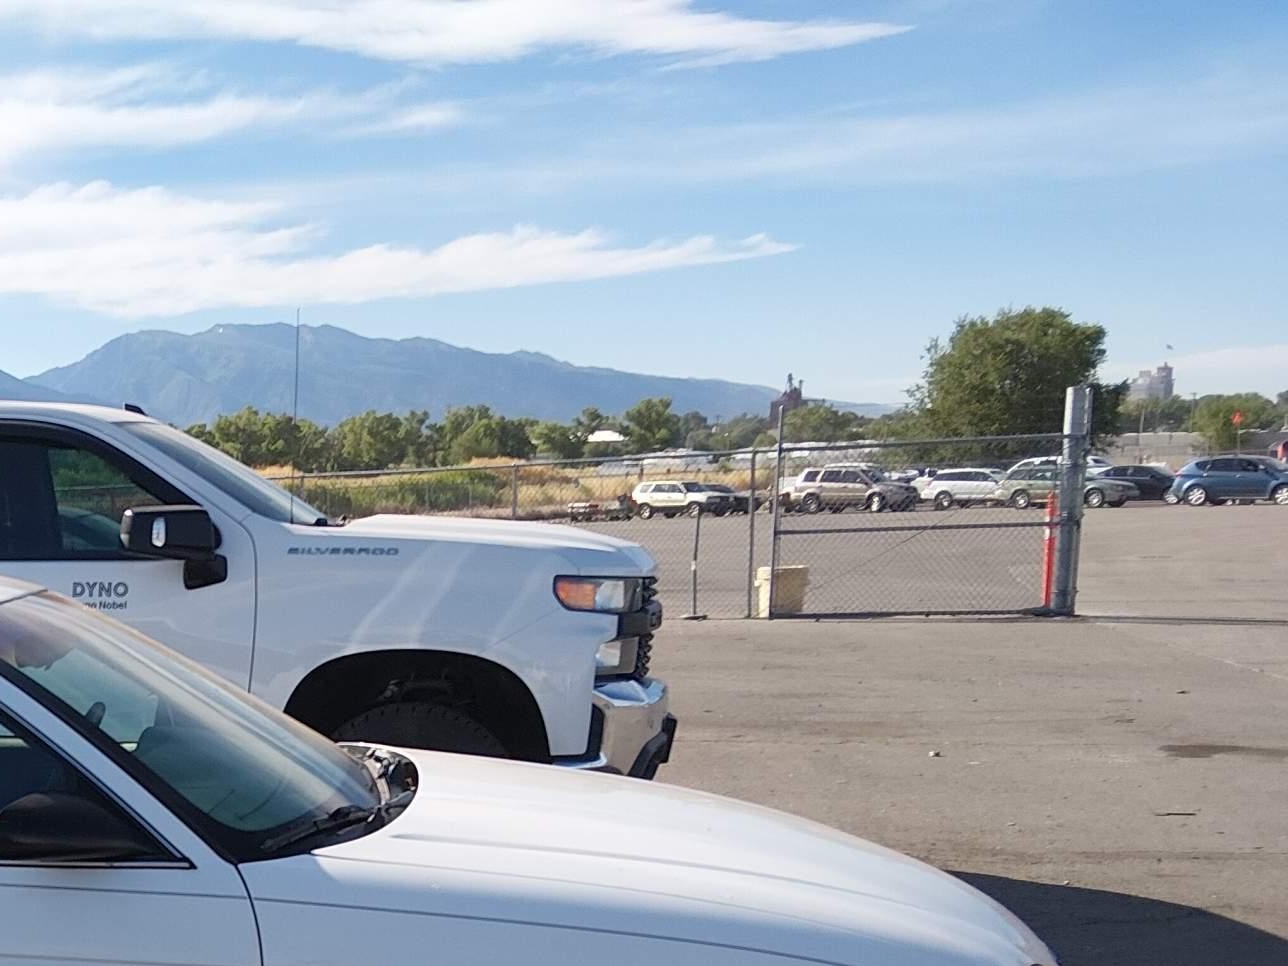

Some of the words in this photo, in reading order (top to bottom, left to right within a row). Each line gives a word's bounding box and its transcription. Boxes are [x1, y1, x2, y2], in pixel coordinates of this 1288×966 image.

[287, 546, 400, 556] SILVERADO
[72, 581, 129, 598] DYNO
[99, 600, 128, 610] Nobel
